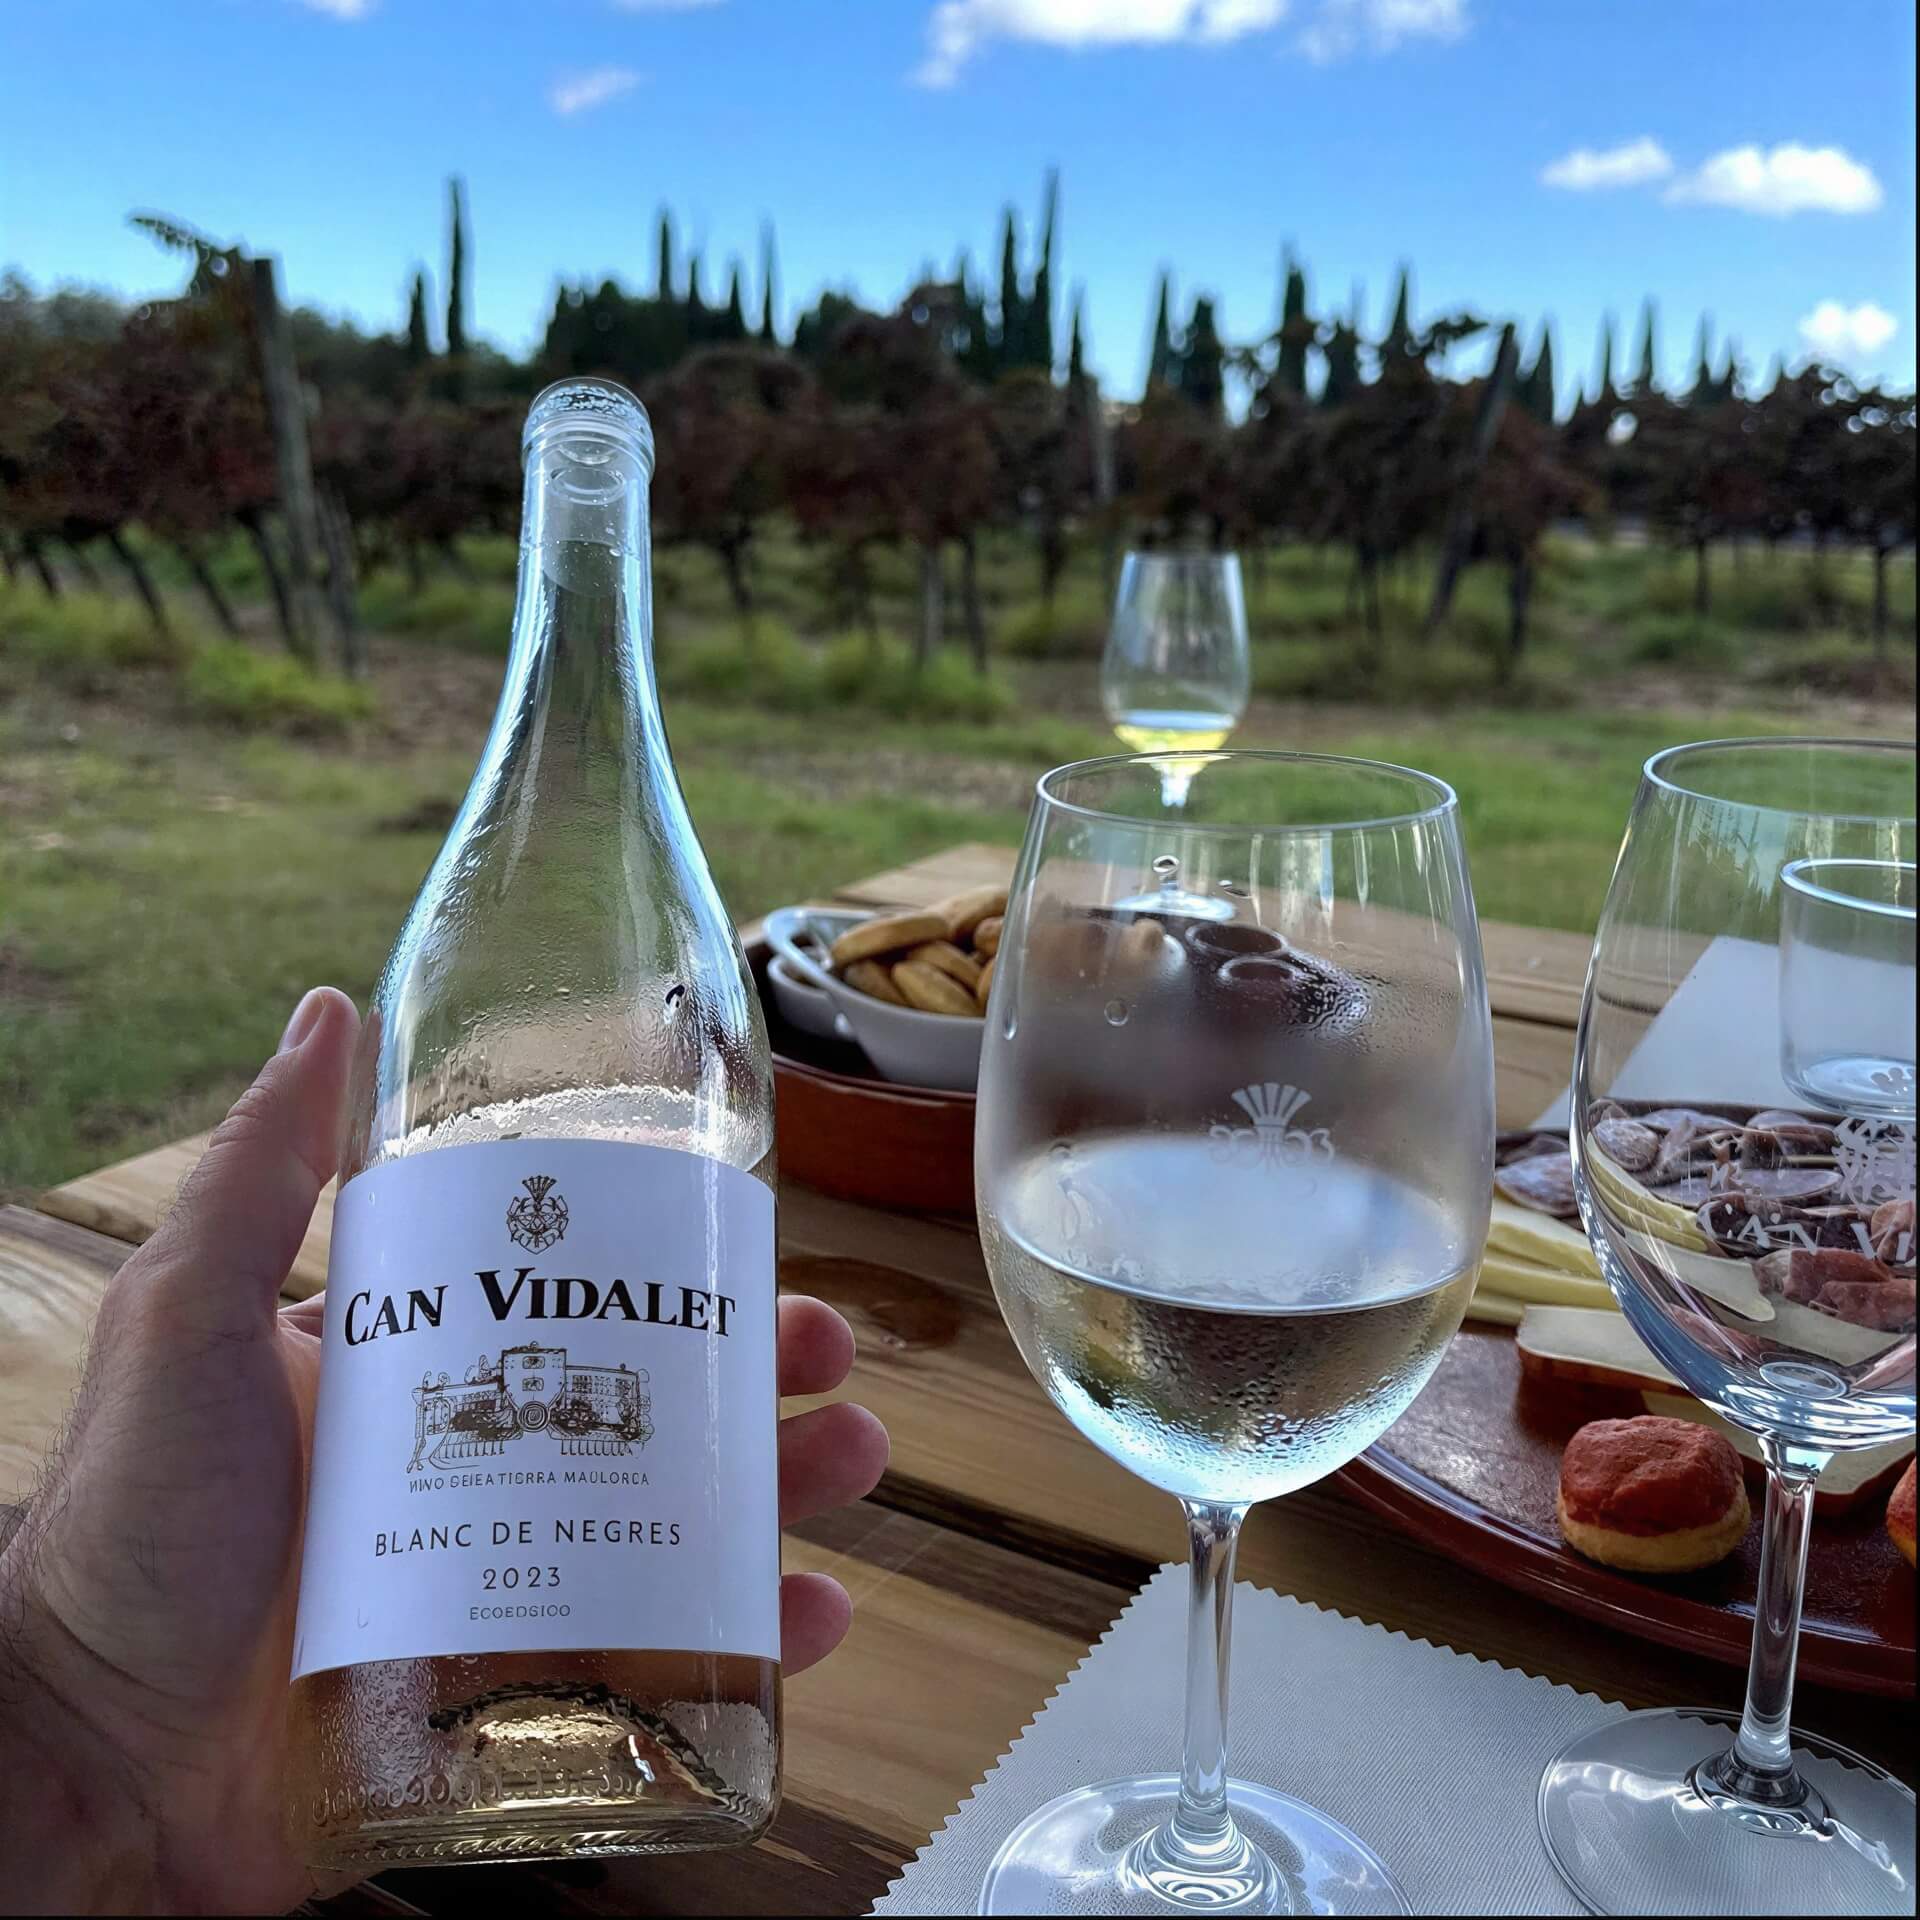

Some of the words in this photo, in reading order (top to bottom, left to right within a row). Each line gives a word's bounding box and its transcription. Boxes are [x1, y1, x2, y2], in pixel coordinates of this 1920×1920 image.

[345, 1285, 448, 1346] CAN
[475, 1267, 735, 1336] VIDALET
[374, 1524, 472, 1556] BLANC
[493, 1521, 532, 1544] DE
[555, 1519, 681, 1545] NEGRES
[481, 1566, 562, 1590] 2023
